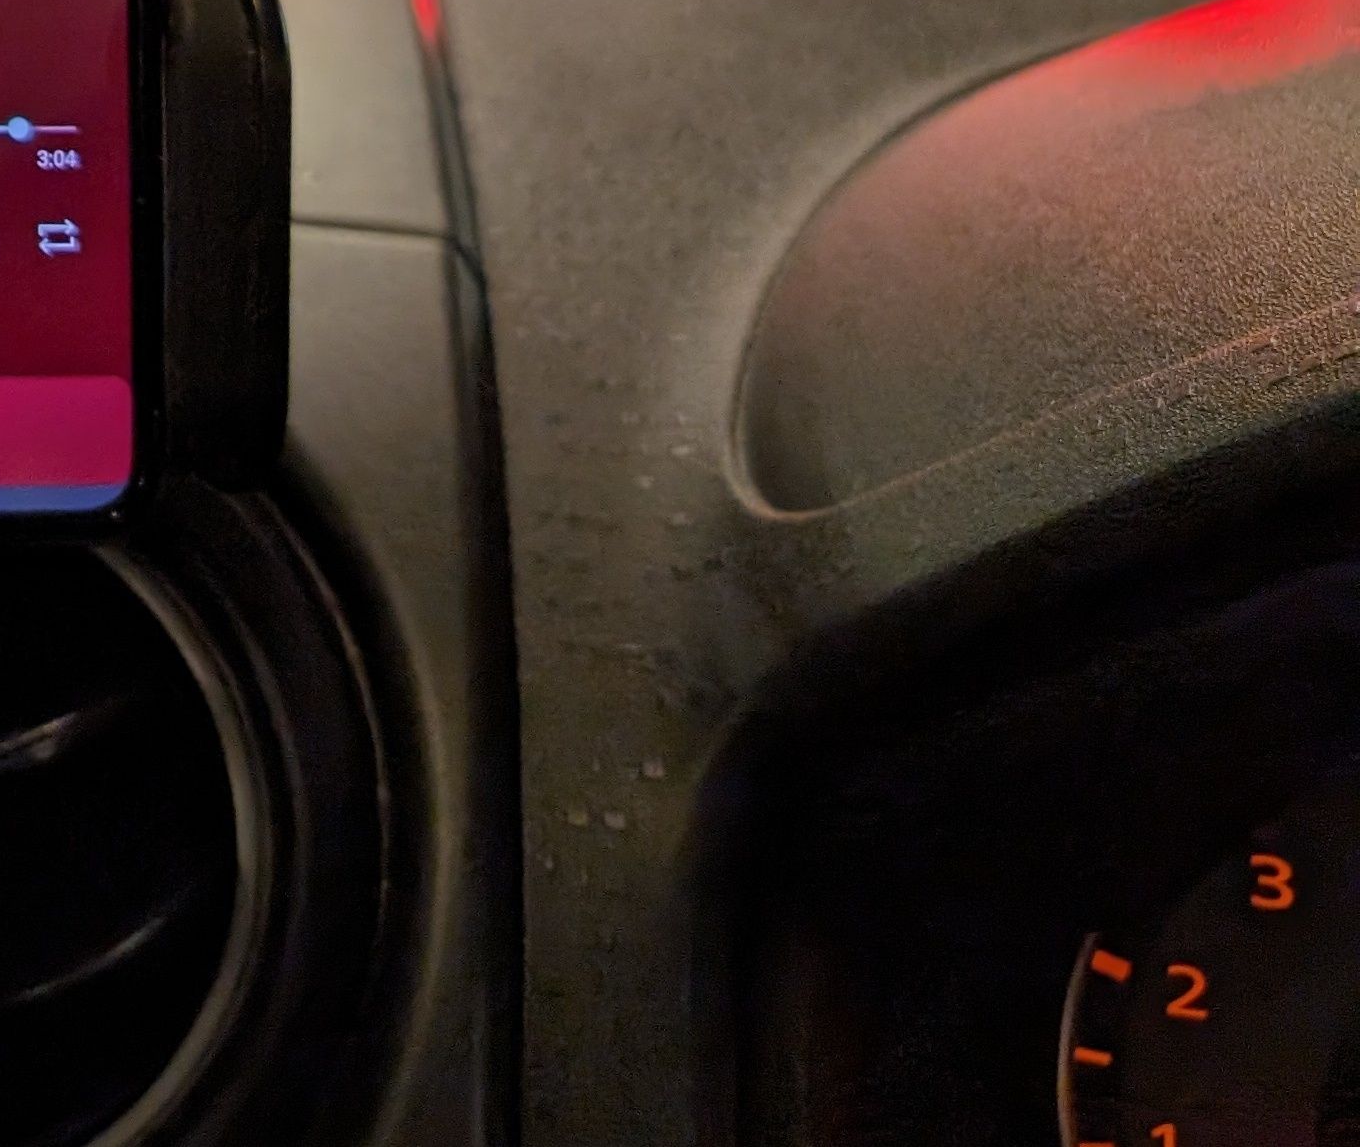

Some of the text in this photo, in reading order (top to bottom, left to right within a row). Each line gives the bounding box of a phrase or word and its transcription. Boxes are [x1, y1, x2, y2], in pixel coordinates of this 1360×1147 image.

[36, 150, 80, 171] 3:04
[1249, 853, 1295, 910] 3
[1166, 963, 1210, 1021] 2
